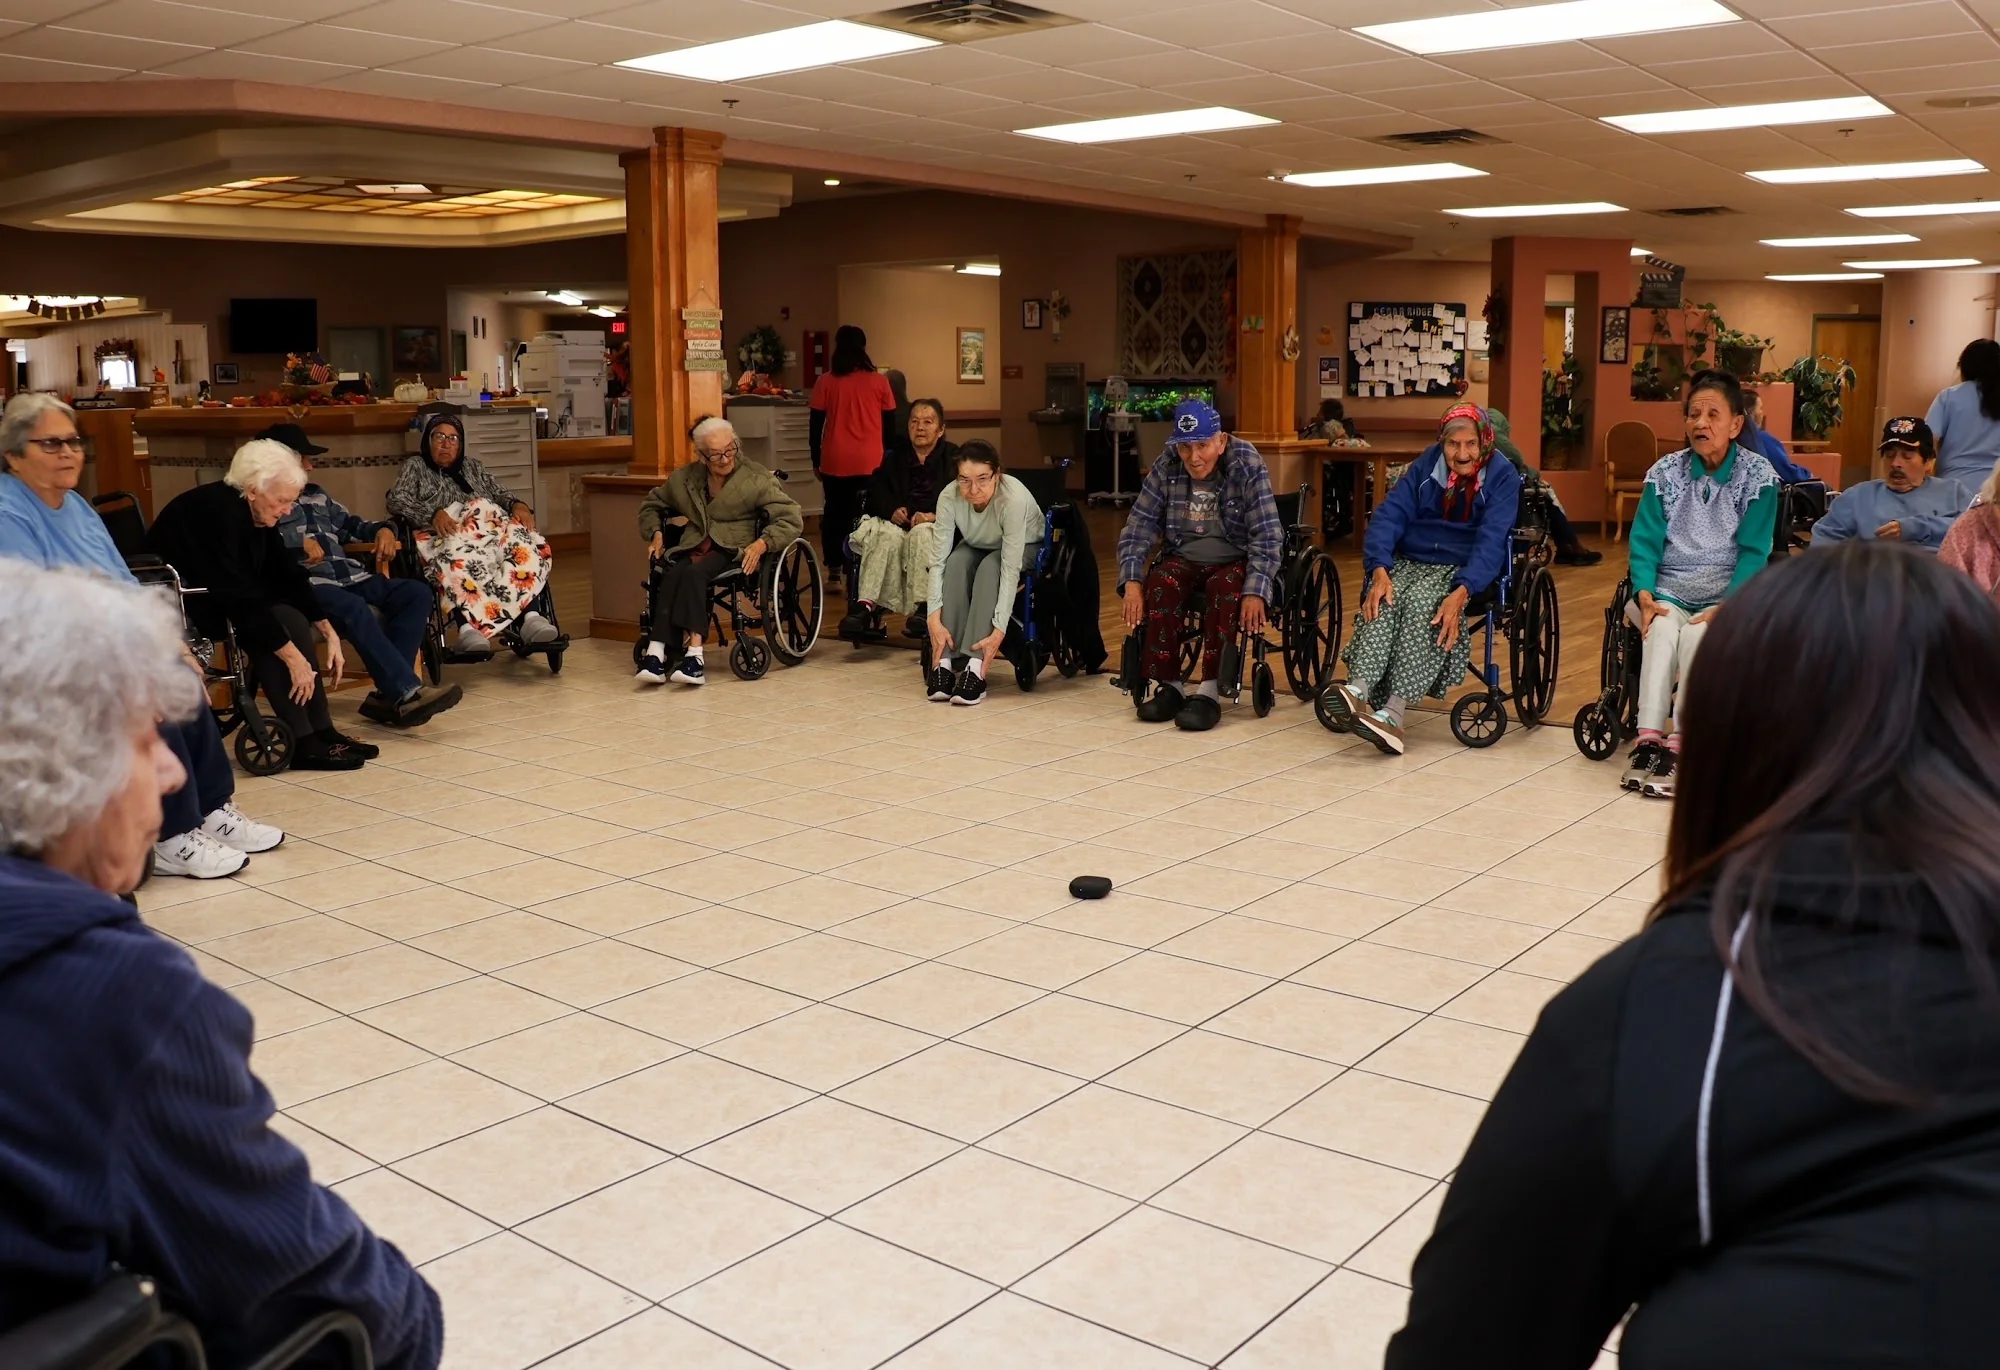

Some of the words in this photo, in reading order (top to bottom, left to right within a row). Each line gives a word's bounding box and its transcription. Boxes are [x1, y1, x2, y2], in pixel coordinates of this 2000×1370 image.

[1407, 307, 1433, 317] RIDGE
[612, 322, 625, 333] EXIT
[689, 351, 720, 359] HAYRIDES
